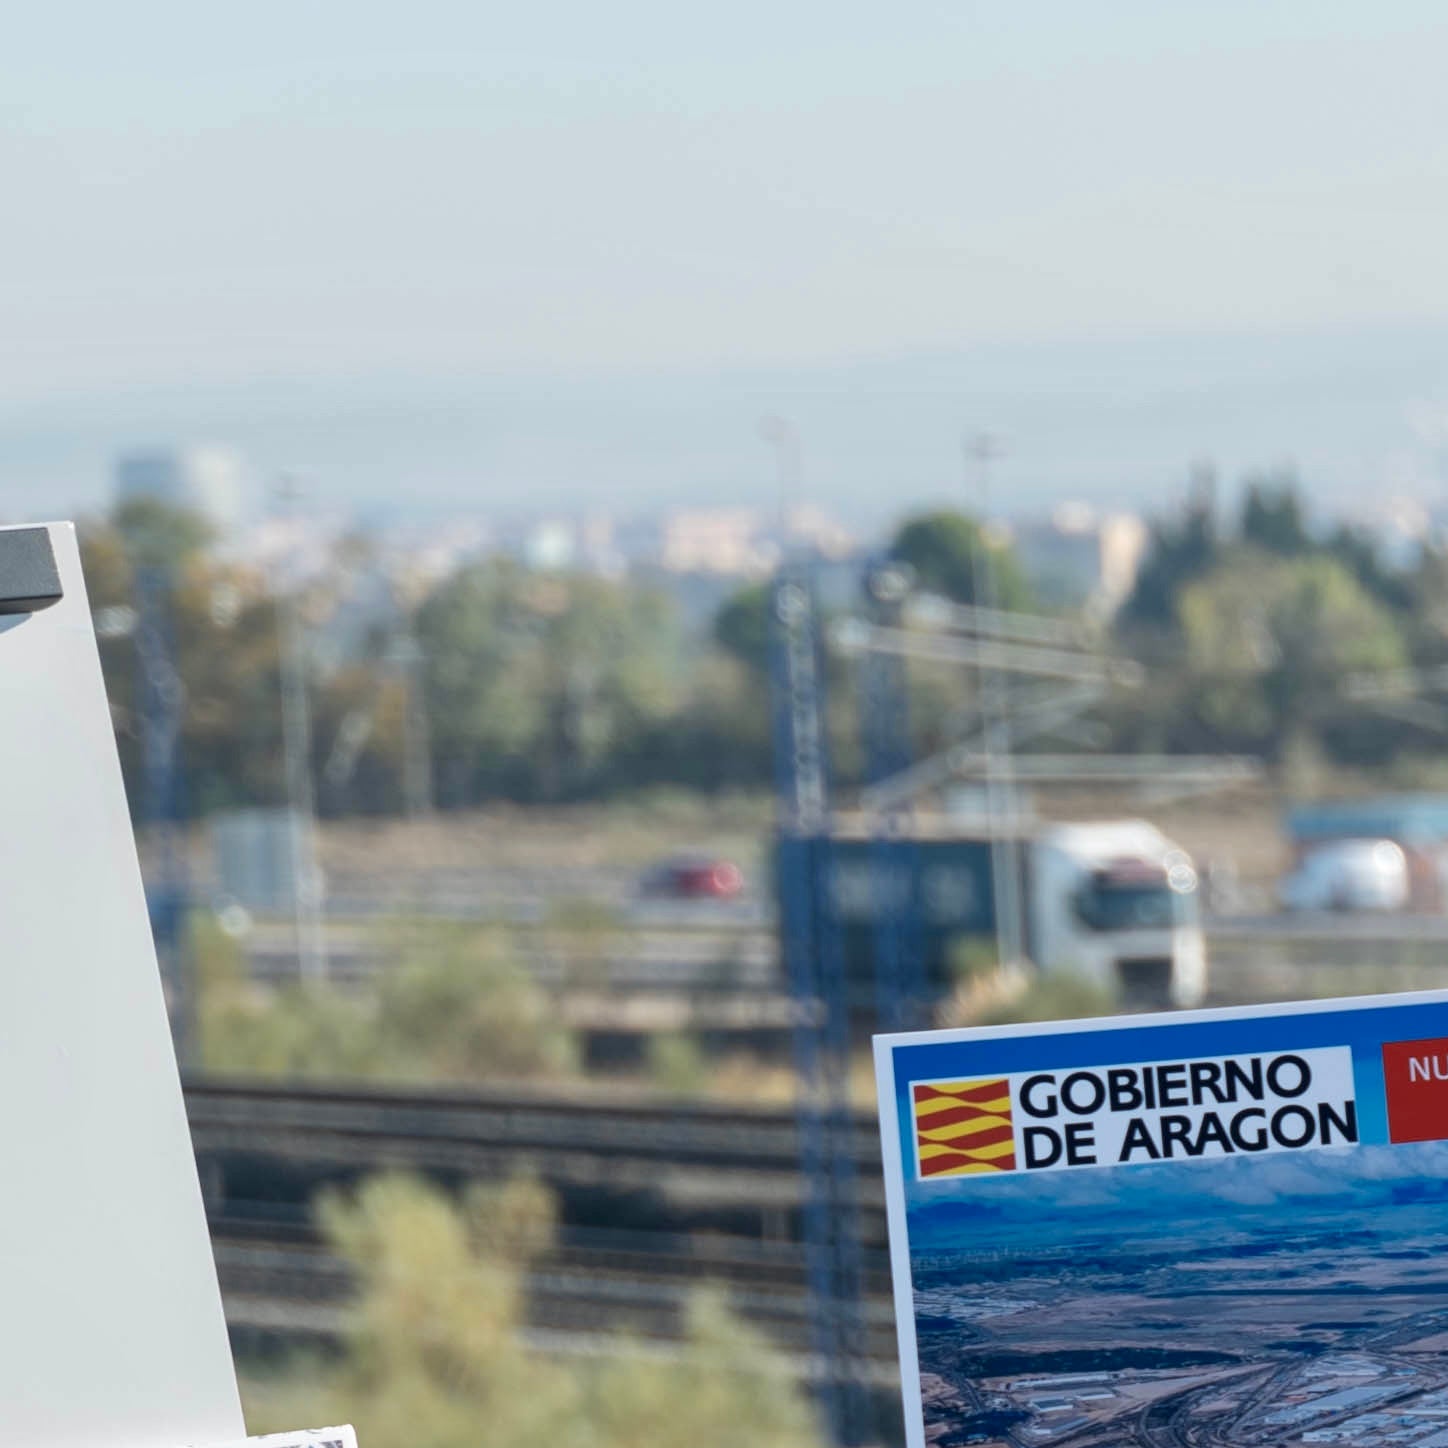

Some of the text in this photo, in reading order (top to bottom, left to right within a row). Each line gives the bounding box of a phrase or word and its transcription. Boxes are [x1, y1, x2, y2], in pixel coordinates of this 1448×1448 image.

[1019, 1054, 1312, 1119] GOBIERNO
[1022, 1100, 1359, 1170] DE ARAGON
